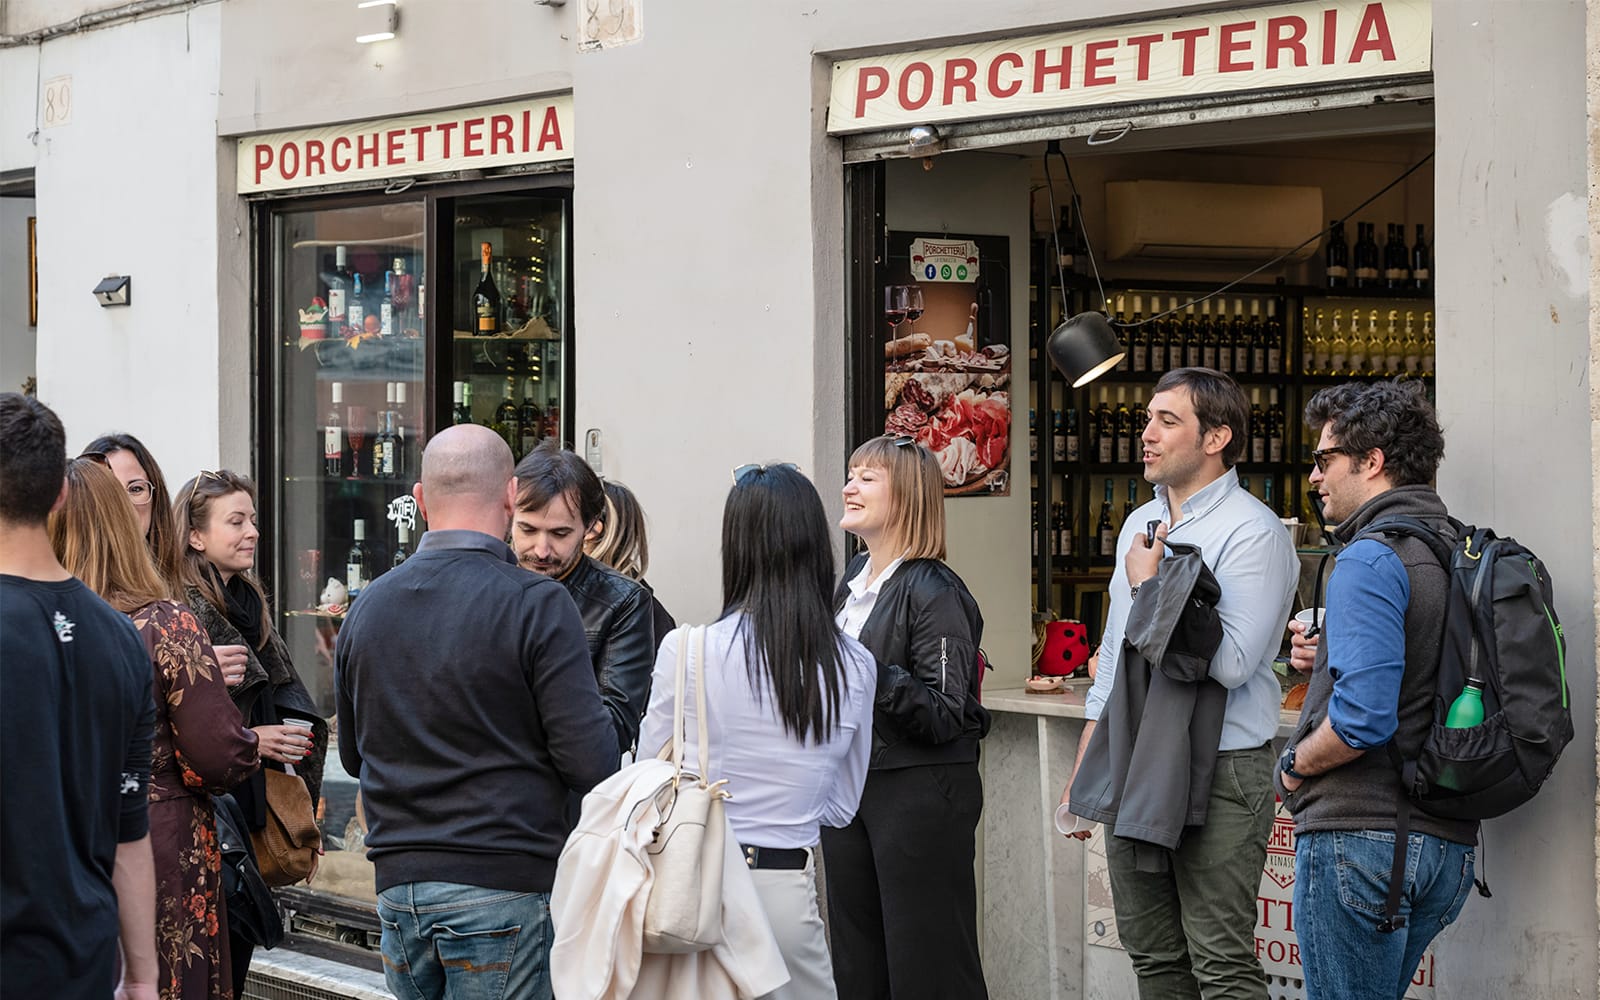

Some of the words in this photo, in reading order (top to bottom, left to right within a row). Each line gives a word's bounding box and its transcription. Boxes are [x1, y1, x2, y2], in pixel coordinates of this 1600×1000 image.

[854, 2, 1396, 119] PORCHETTERIA
[45, 84, 70, 123] 89
[255, 106, 563, 185] PORCHETTERIA
[925, 244, 965, 257] PORCHETTERIA
[1267, 824, 1295, 848] HET
